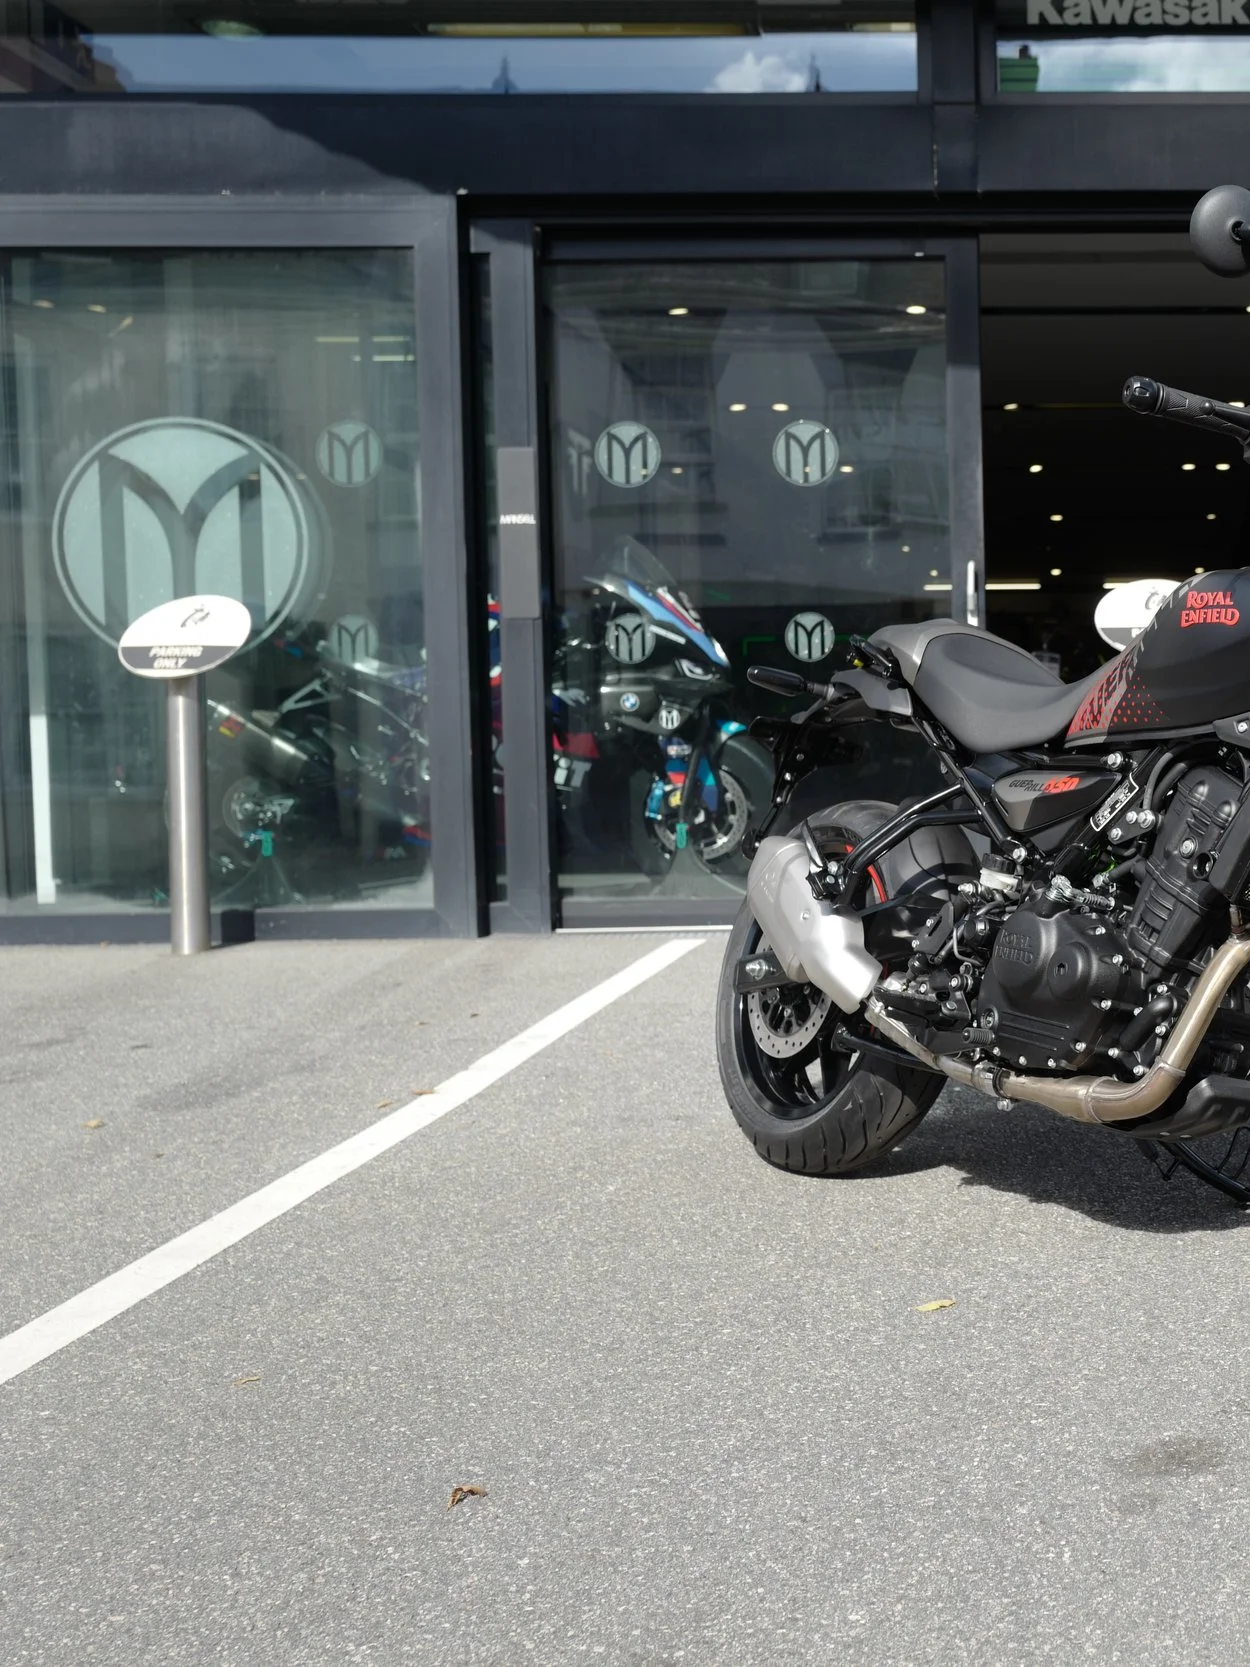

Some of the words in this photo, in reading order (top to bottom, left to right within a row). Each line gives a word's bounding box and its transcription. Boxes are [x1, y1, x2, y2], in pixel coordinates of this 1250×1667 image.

[1186, 590, 1234, 609] ROYAL
[1180, 607, 1240, 628] ENFIELD
[149, 645, 203, 658] PARKING
[153, 657, 188, 669] ONLY
[999, 928, 1033, 950] ROYAL
[994, 944, 1034, 968] ENFIELD
